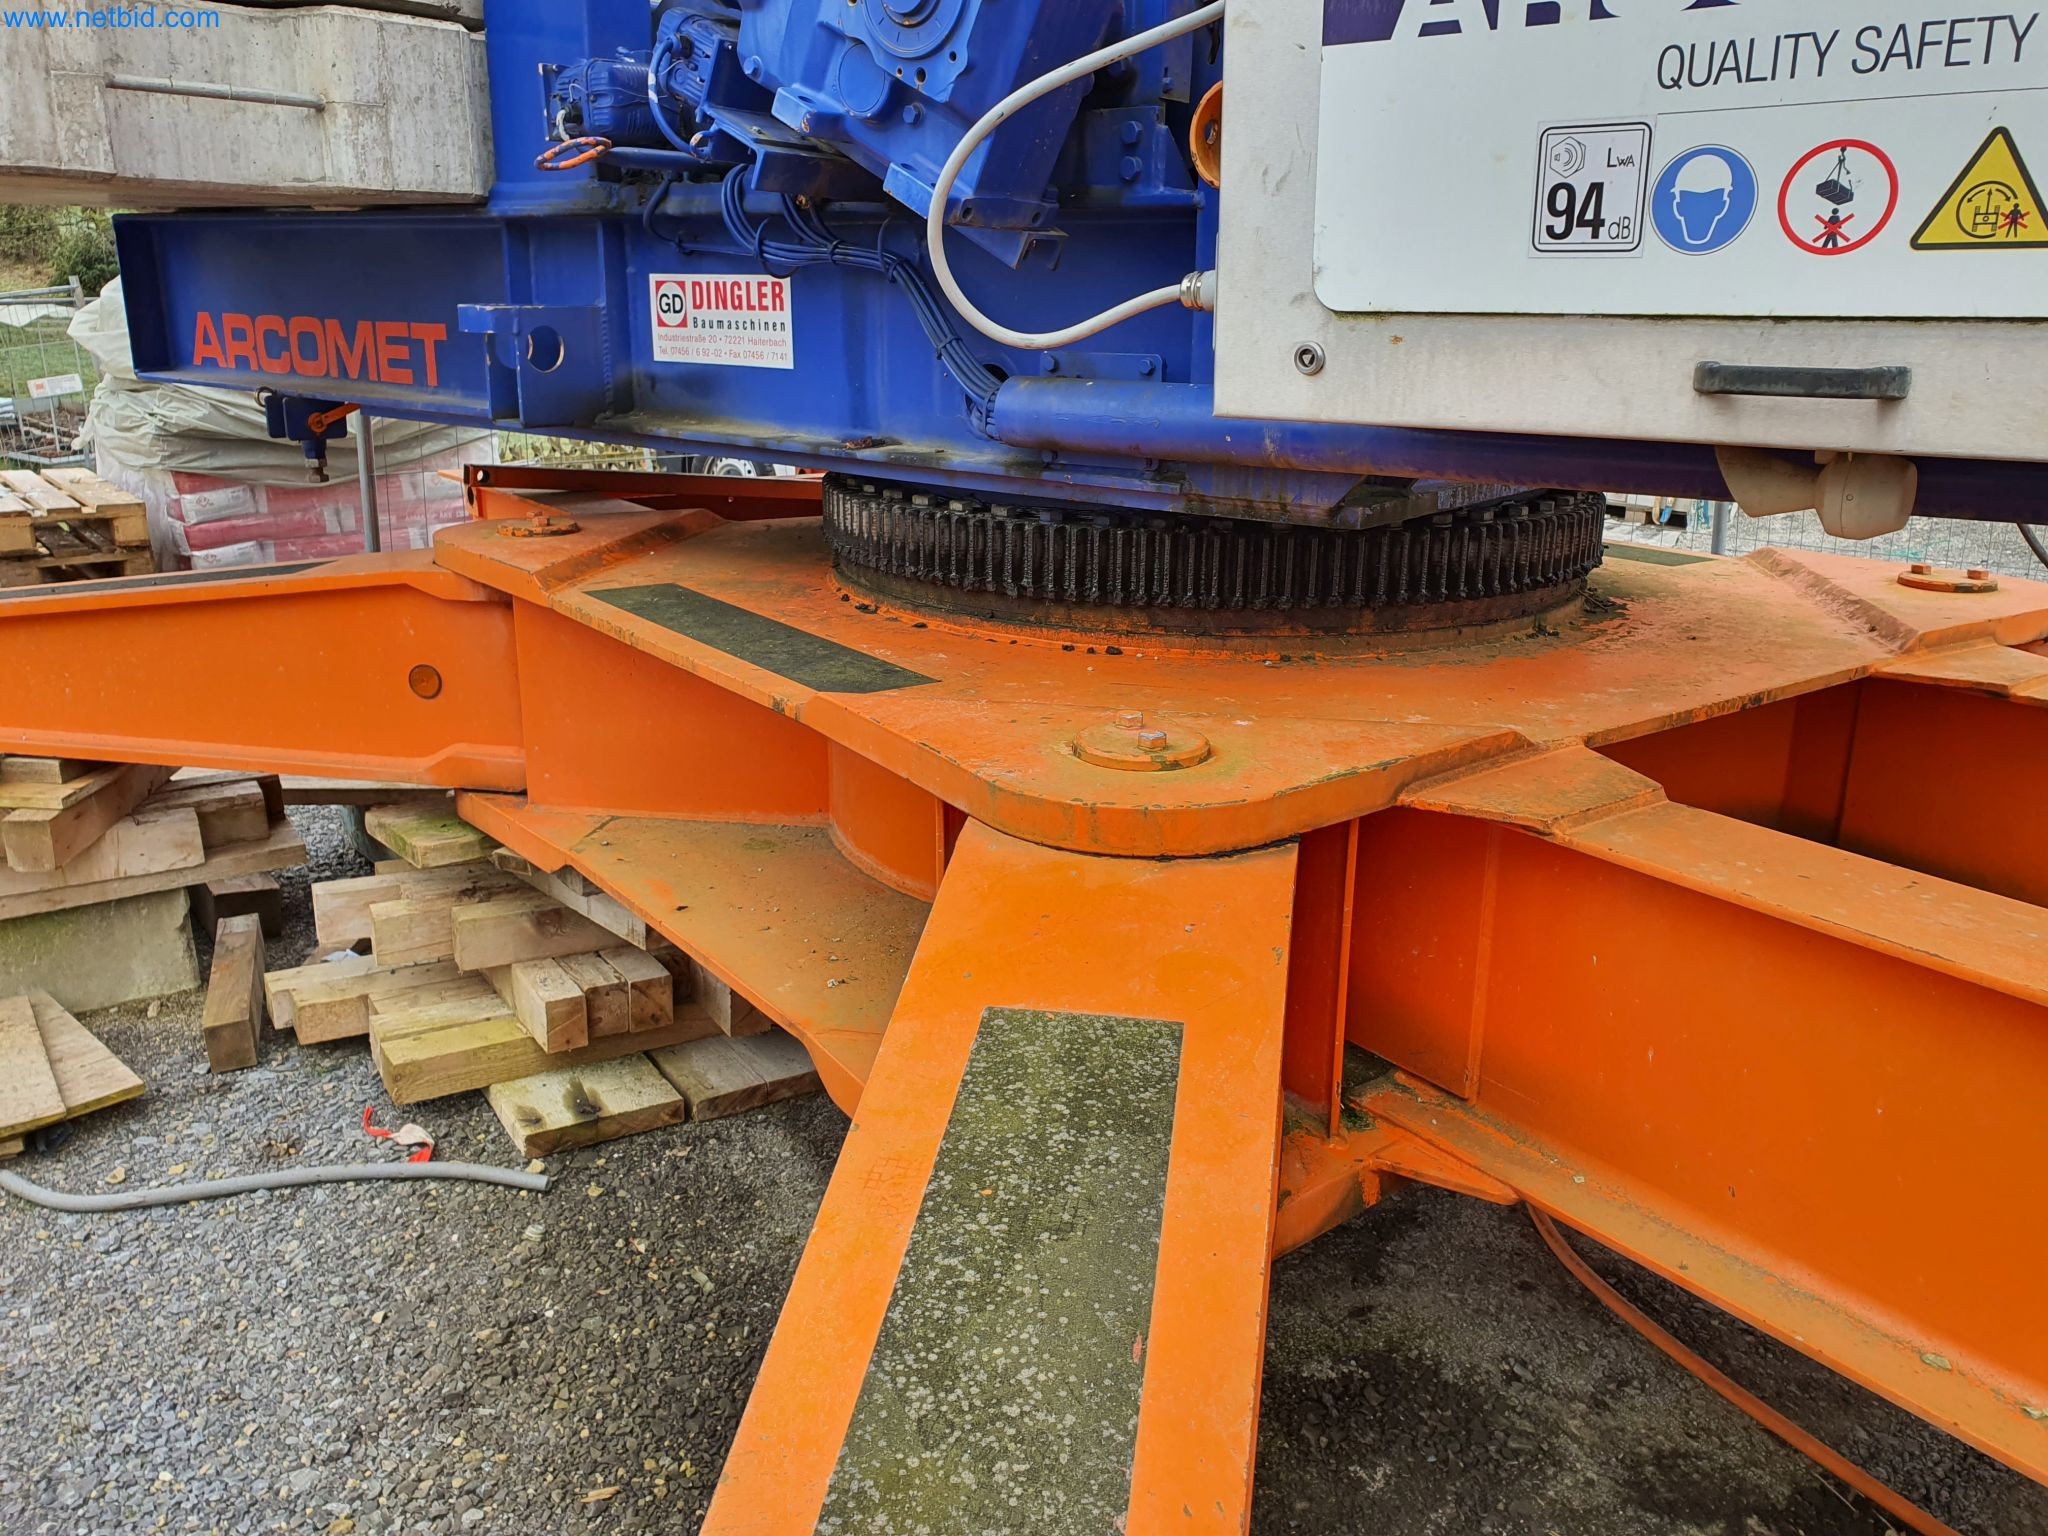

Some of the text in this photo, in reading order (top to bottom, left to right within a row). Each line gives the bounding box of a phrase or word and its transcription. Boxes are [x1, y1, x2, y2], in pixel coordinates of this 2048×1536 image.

[1657, 12, 2040, 90] QUALITY SAFETY
[1545, 181, 1632, 240] 94 dB
[658, 293, 684, 315] GD
[691, 280, 785, 312] DINGLER
[692, 316, 786, 332] Baumaschinen
[193, 311, 448, 387] ARCOMET
[657, 333, 787, 347] Industriestraße 20 72221 Haiterbach
[670, 346, 690, 356] 07456
[729, 349, 741, 359] Fax
[742, 350, 765, 360] 07456
[770, 351, 788, 361] 7141
